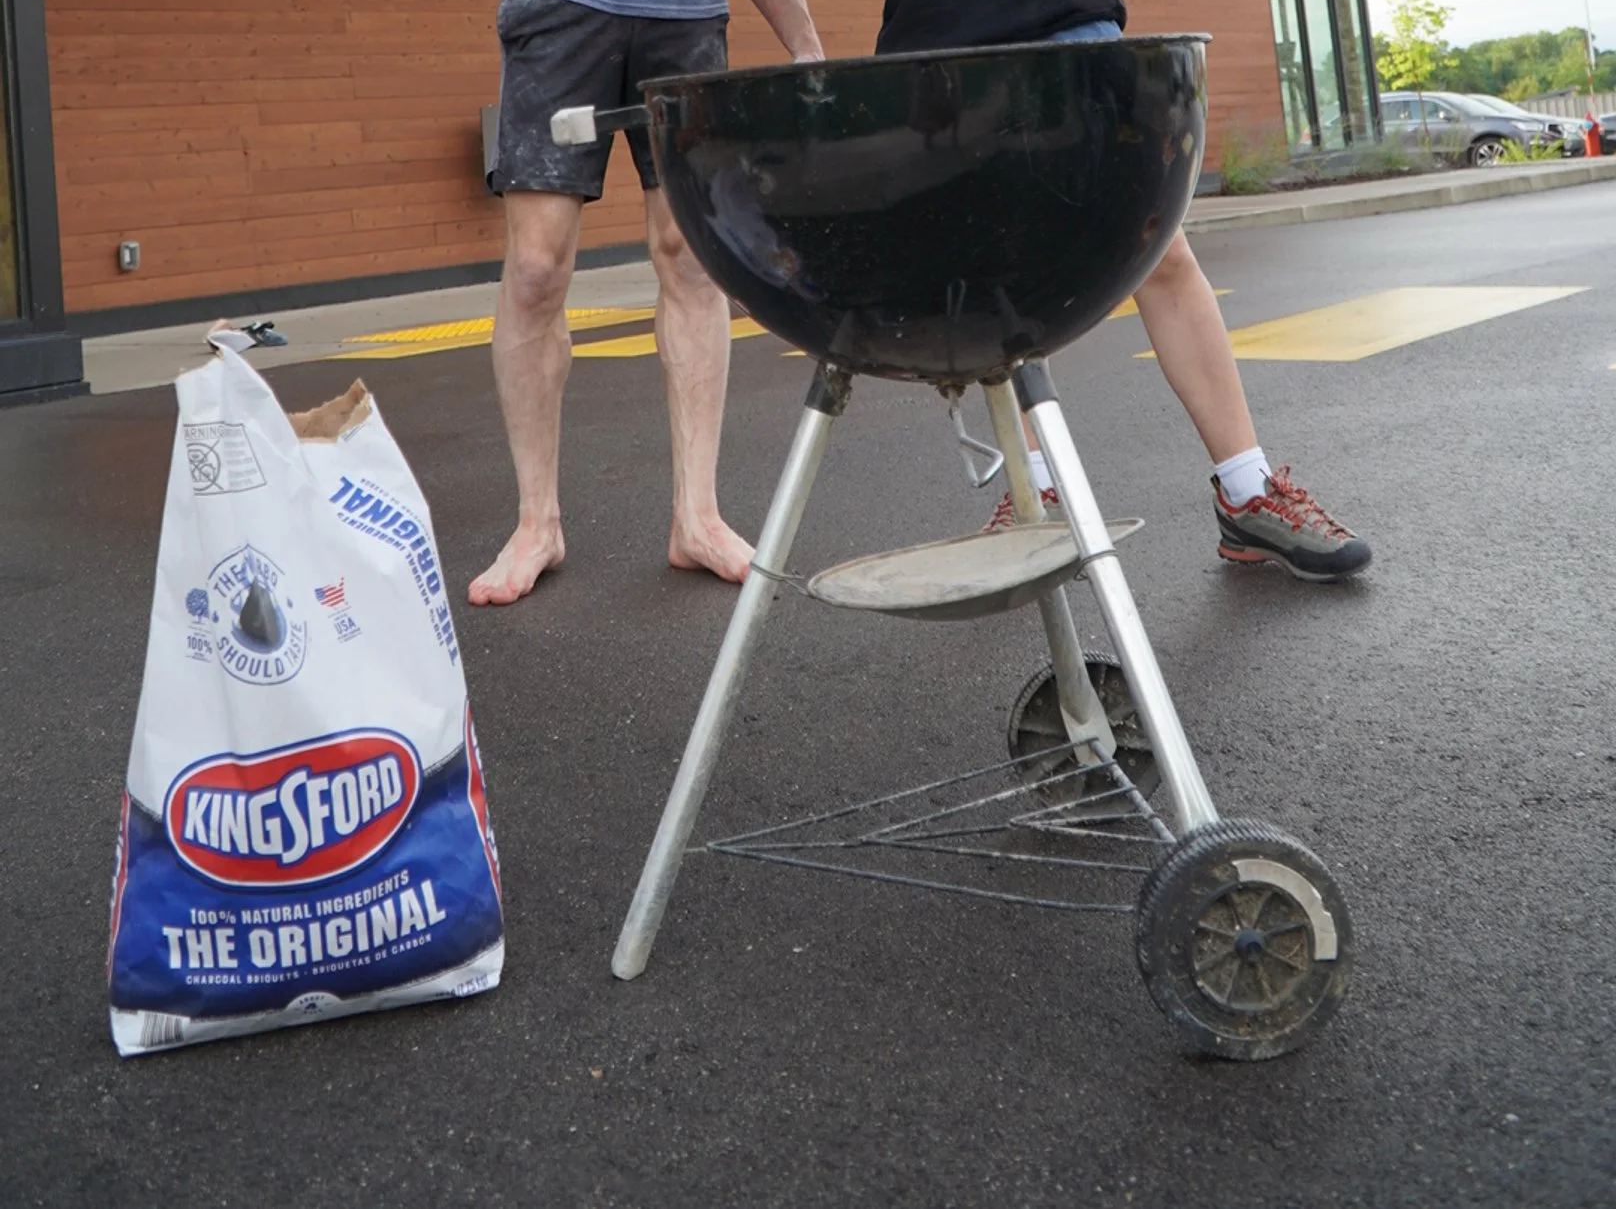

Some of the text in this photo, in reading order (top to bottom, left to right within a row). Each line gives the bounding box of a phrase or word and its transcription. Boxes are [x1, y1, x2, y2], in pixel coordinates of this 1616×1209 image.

[329, 476, 442, 596] ORIGINAL
[213, 564, 243, 598] THE
[186, 635, 212, 654] 100%
[334, 616, 357, 635] USA
[216, 637, 286, 678] SHOULD
[184, 757, 402, 864] KINGSFORD
[189, 870, 410, 925] 100% NATURAL INGREDIENTS
[162, 879, 447, 969] THE ORIGINAL
[185, 973, 242, 985] CHARCOAL
[246, 971, 299, 984] BRIQUETS
[312, 957, 371, 976] BRIQUETAS
[375, 950, 388, 961] DE
